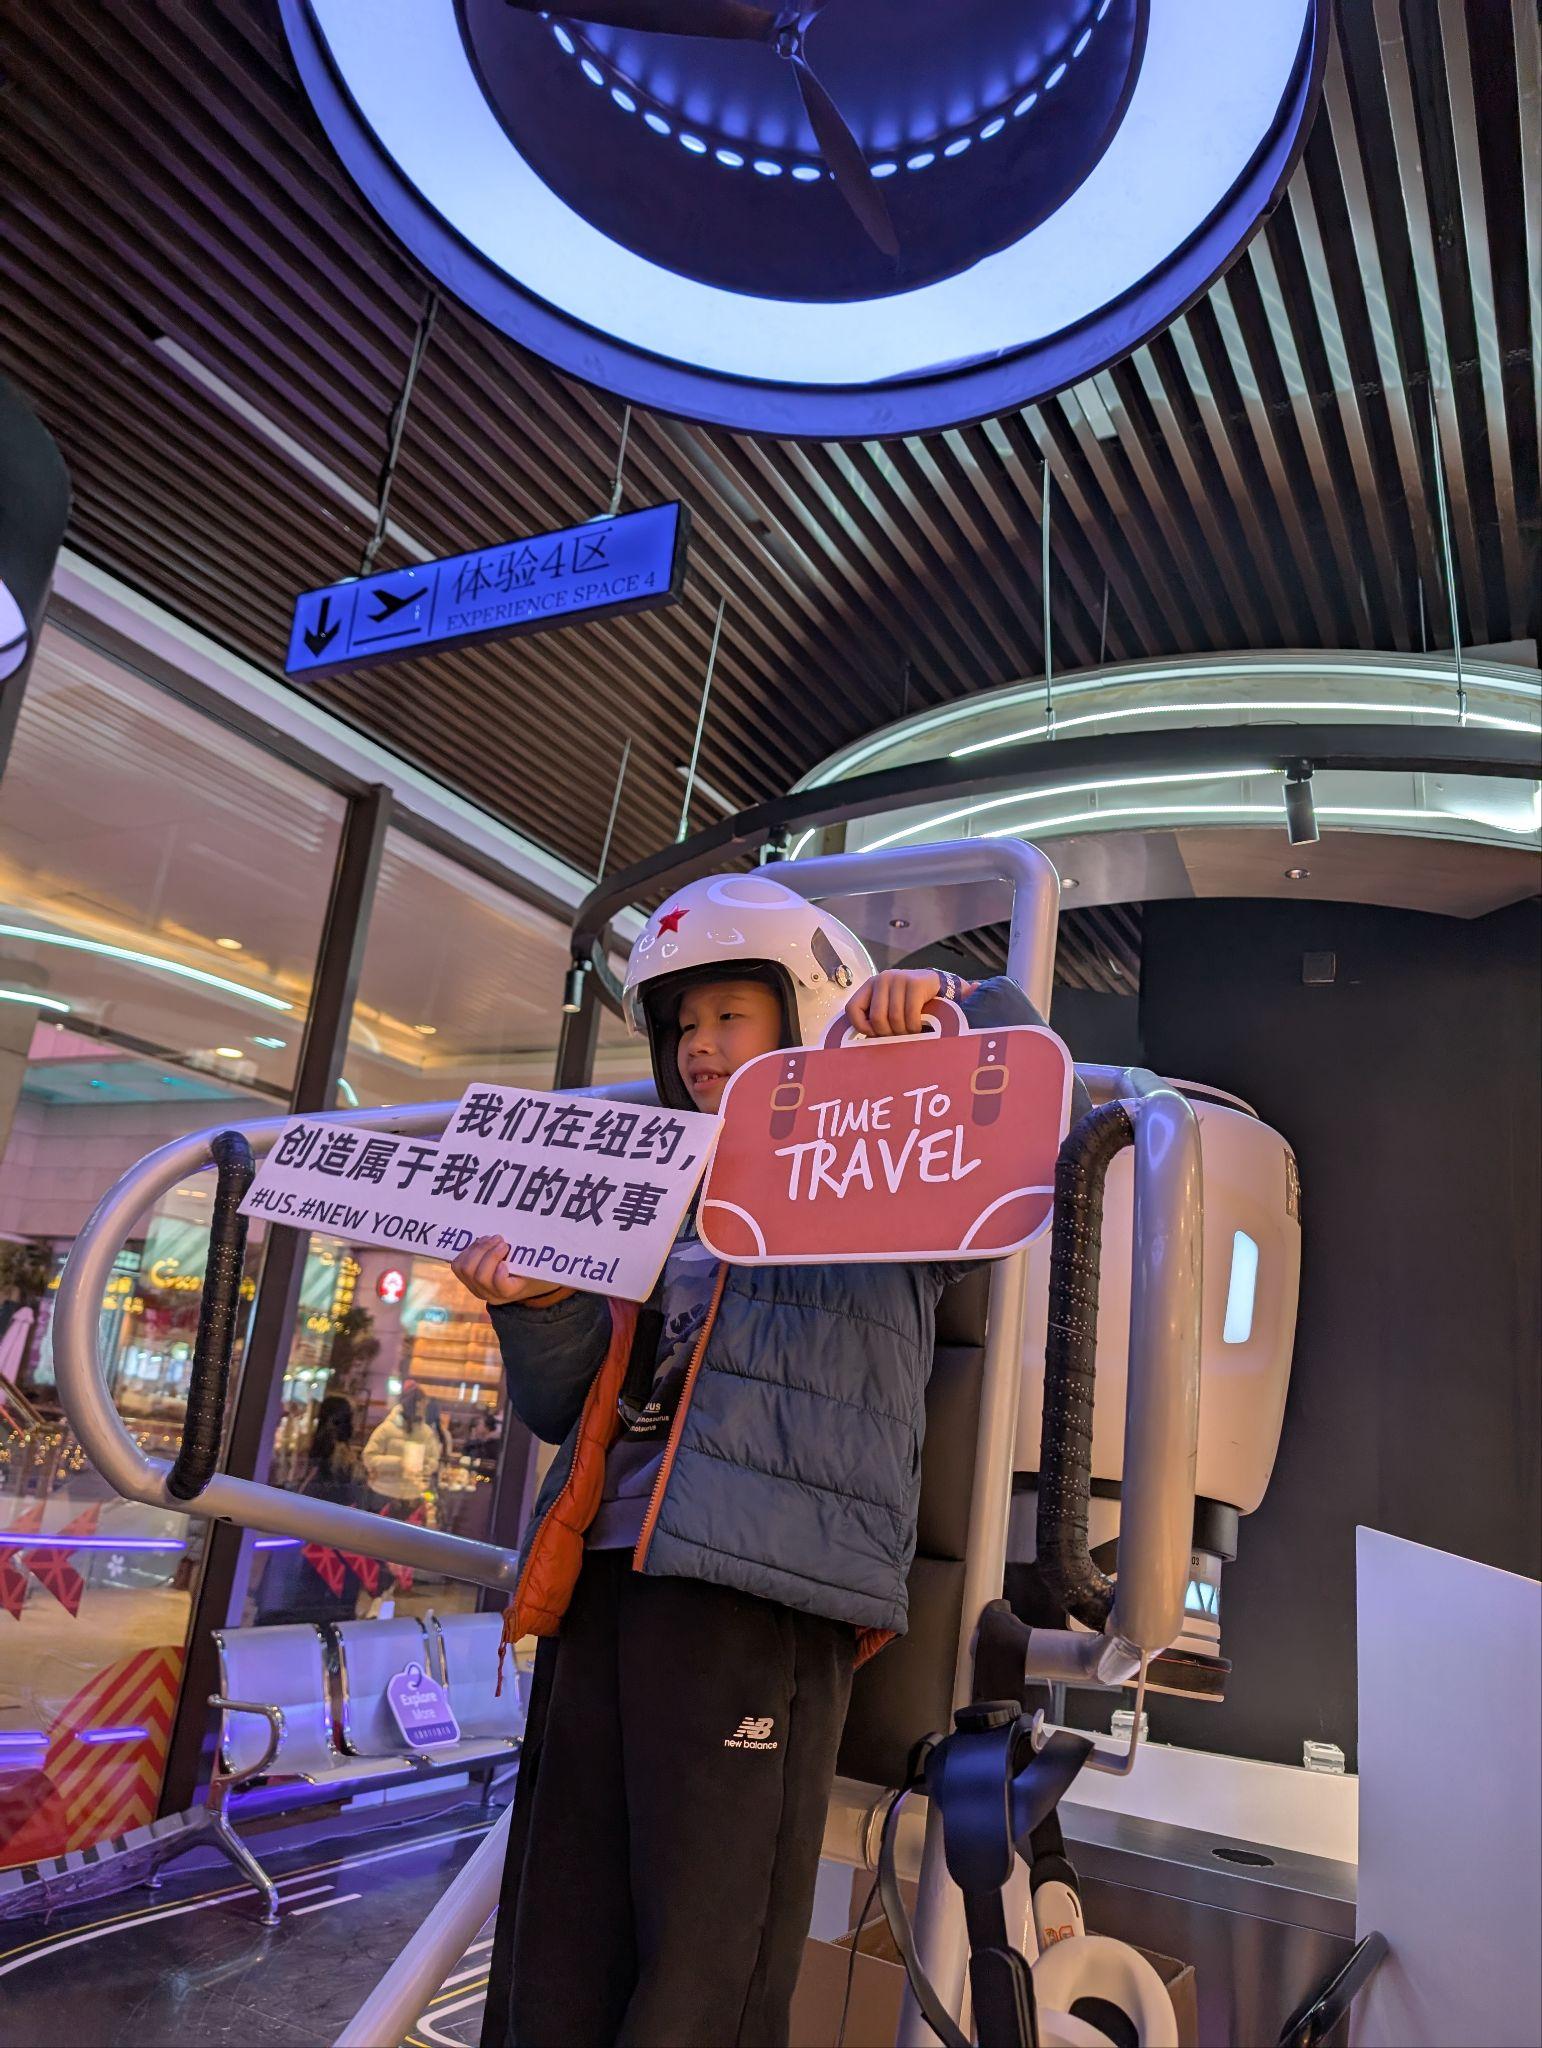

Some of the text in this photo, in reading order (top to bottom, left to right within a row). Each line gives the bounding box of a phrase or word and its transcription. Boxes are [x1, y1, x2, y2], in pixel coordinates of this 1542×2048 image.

[453, 527, 613, 604] 体验4区
[447, 571, 655, 631] EXPERIENCE SPACE 4
[808, 1097, 894, 1138] TIME
[275, 1123, 669, 1232] 创造属于我们的故事
[774, 1124, 982, 1201] TRAVEL
[371, 1212, 439, 1246] YORK
[436, 1227, 620, 1285] #DmPortal
[400, 1691, 438, 1707] Explore
[724, 1739, 778, 1749] new balance
